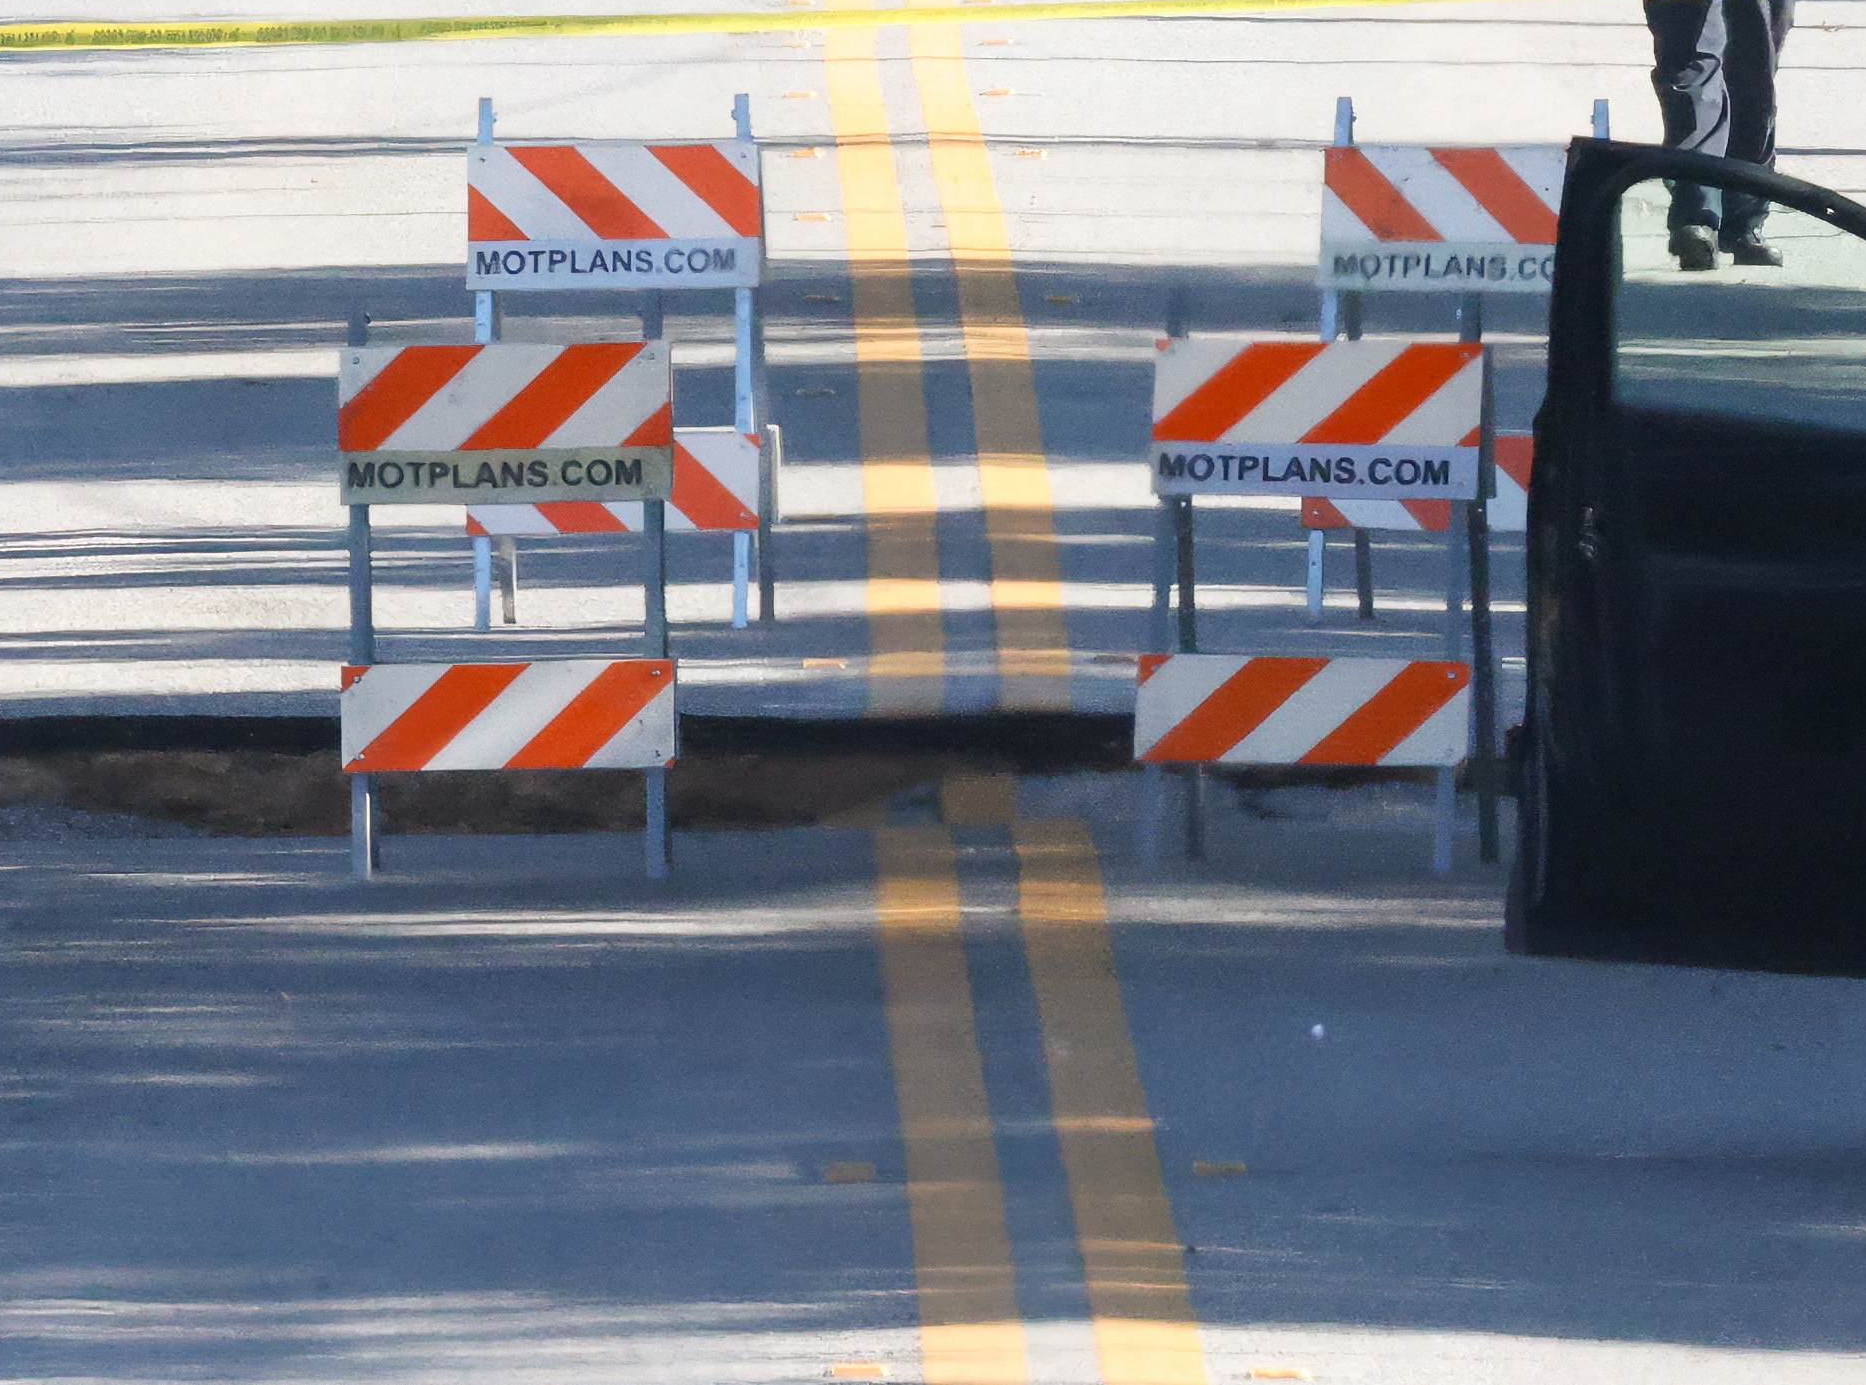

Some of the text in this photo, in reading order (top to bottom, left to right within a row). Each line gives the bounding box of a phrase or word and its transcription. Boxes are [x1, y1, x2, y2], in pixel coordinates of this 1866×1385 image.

[476, 248, 736, 275] MOTPLANS.COM
[347, 459, 643, 489] MOTPLANS.COM
[1159, 452, 1449, 485] MOTPLANS.COM
